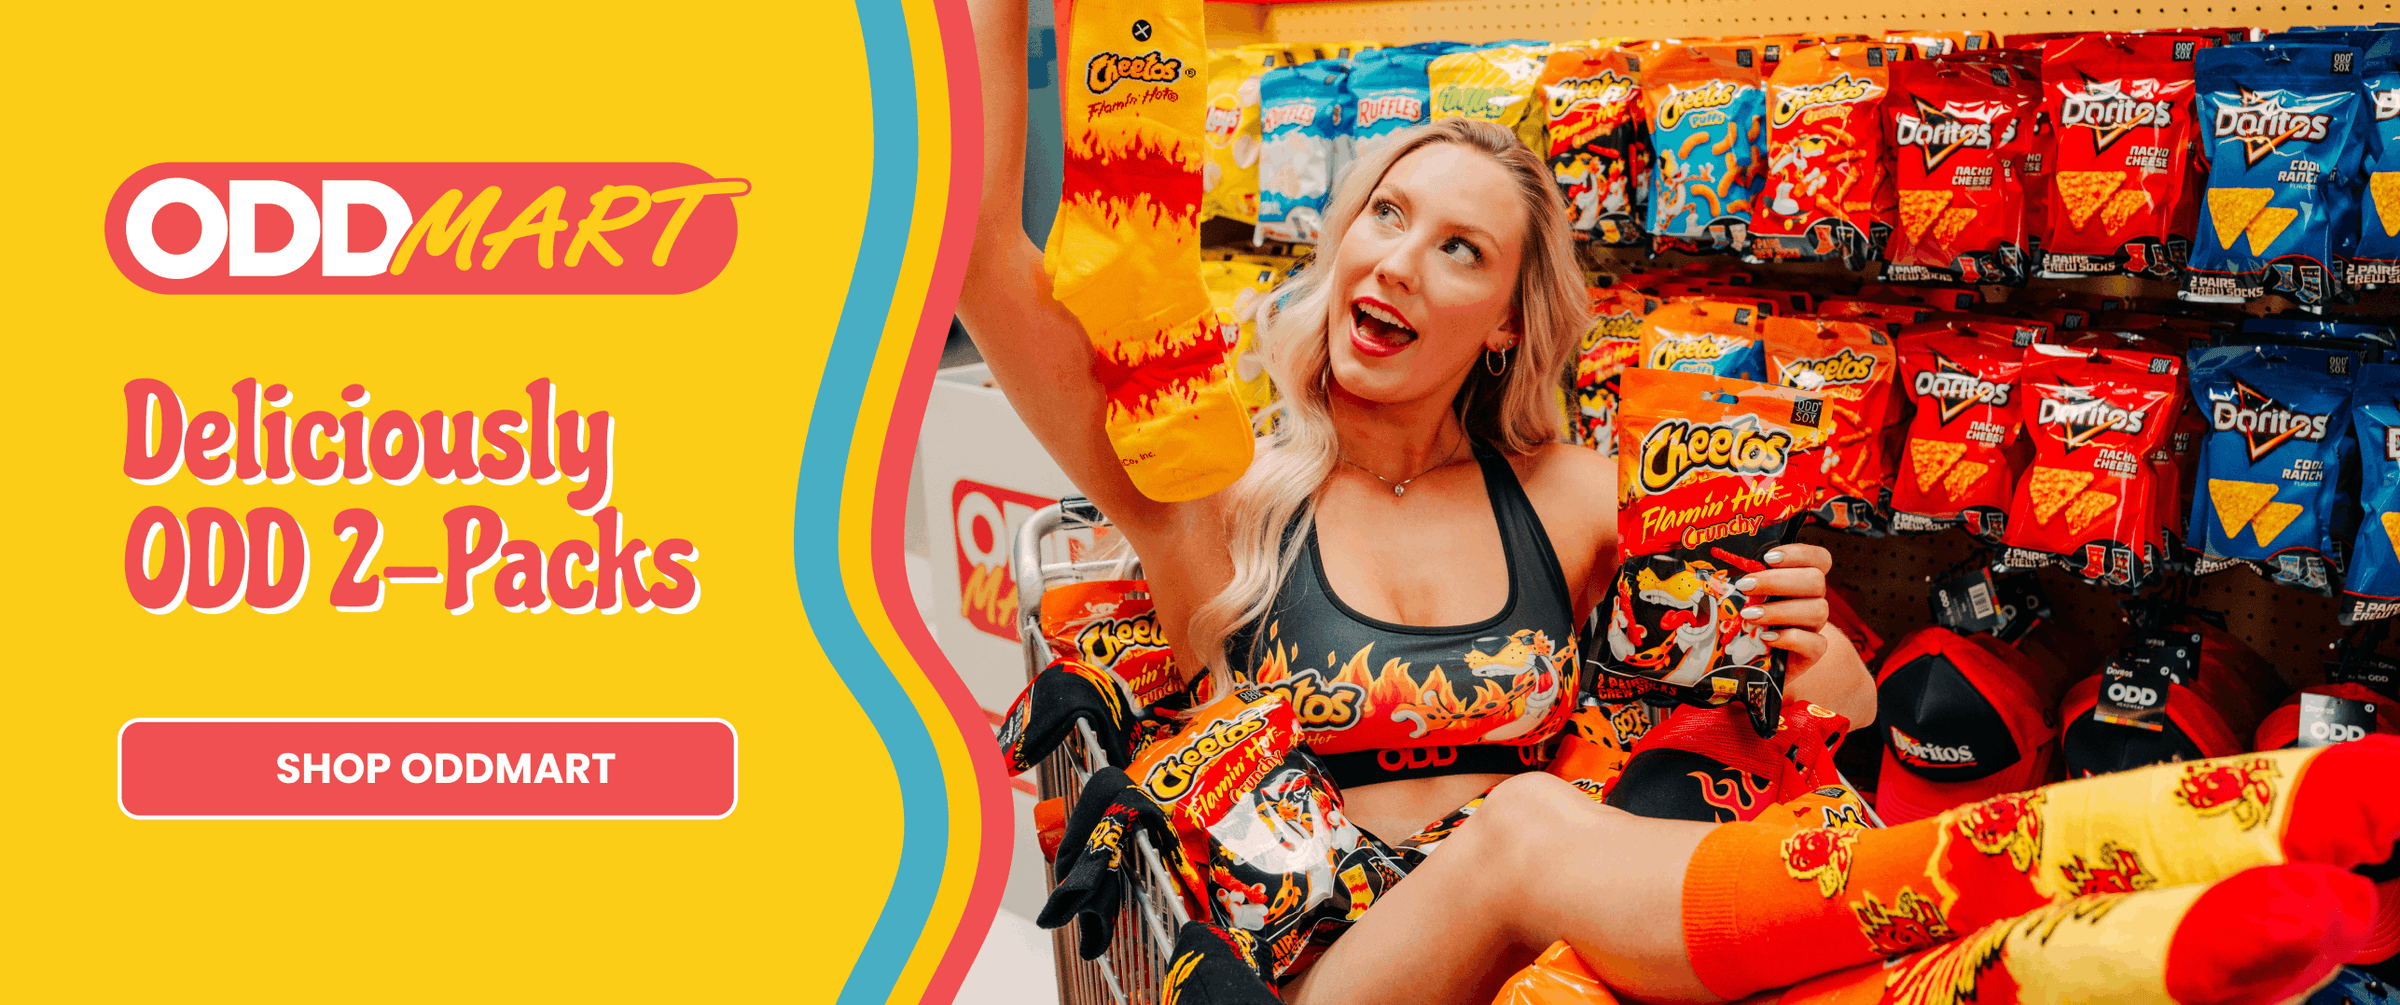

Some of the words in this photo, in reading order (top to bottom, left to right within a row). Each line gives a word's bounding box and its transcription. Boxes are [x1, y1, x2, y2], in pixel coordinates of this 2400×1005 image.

[1085, 49, 1184, 95] Cheetos
[1358, 97, 1422, 126] RUFFLES
[1658, 79, 1737, 131] Cheetos
[1772, 72, 1874, 129] Cheetos
[2062, 99, 2171, 128] Doritos
[2214, 105, 2331, 142] Doritos
[1897, 118, 1993, 150] Doritos
[2125, 156, 2168, 168] CHEESE
[2130, 146, 2169, 157] NACHO
[1952, 176, 1991, 186] CHEESE
[1956, 166, 1993, 176] NACHO
[2044, 262, 2078, 272] CREW
[2079, 262, 2116, 272] SOCKS
[2053, 254, 2089, 264] PAIRS
[2346, 264, 2355, 275] 2
[2200, 276, 2237, 288] PAIRS
[2347, 274, 2386, 285] CREW
[2227, 286, 2264, 298] SOCKS
[1915, 371, 2011, 405] Doritos
[1795, 411, 1818, 424] SOX
[1797, 400, 1819, 413] ODD
[2038, 397, 2147, 436] Doritos
[2213, 401, 2330, 442] Doritos
[1639, 413, 1794, 495] Cheetos
[2094, 459, 2138, 475] CHEESE
[2282, 468, 2324, 482] RANCH
[1641, 490, 1729, 545] Flamin'
[1731, 479, 1787, 512] Hot
[1681, 513, 1764, 550] Crunchy
[2354, 601, 2366, 612] 2
[1598, 687, 1634, 700] CREW
[1608, 676, 1649, 690] PAIRS
[2108, 683, 2158, 706] ODD
[2310, 721, 2366, 743] ODD
[1141, 706, 1269, 805] Cheetos
[1377, 746, 1458, 772] ODD
[1229, 750, 1285, 804] Crunchy
[1185, 756, 1246, 830] Flamin'
[1271, 928, 1299, 960] AIRS
